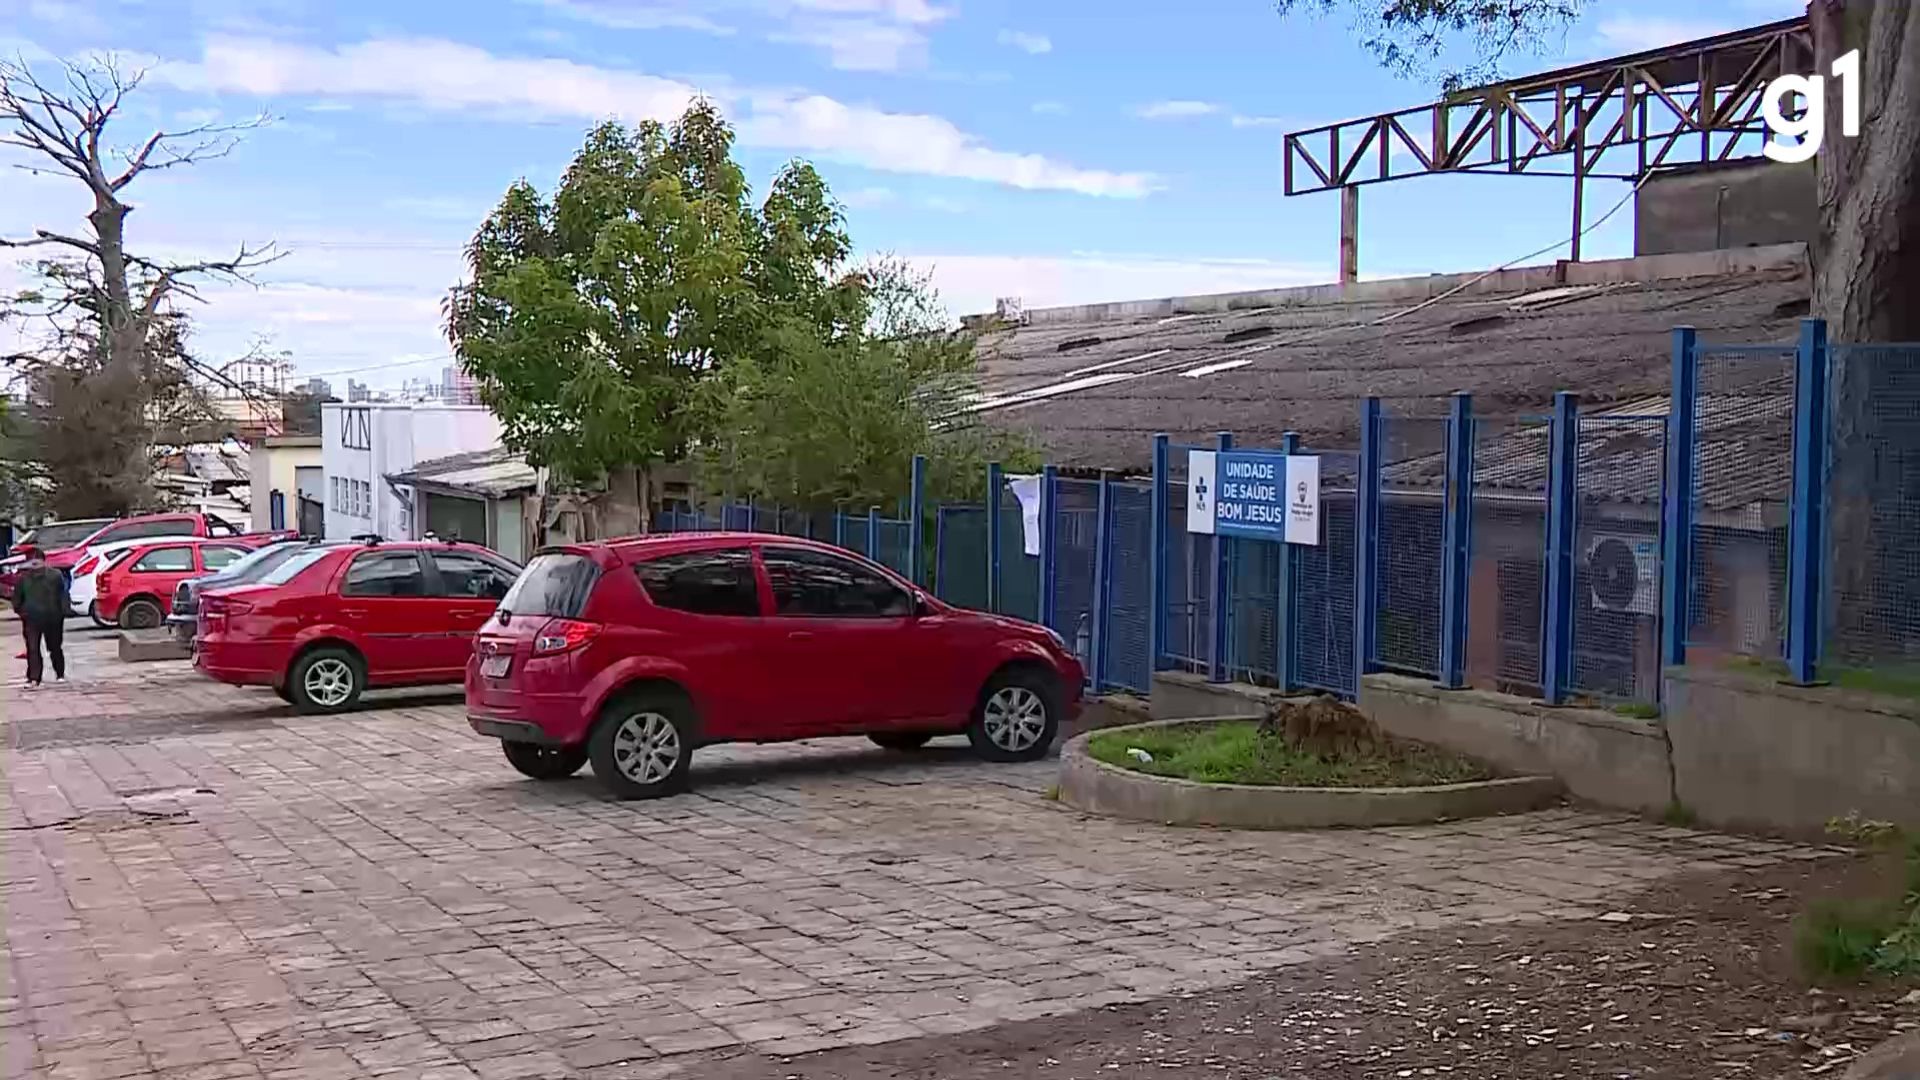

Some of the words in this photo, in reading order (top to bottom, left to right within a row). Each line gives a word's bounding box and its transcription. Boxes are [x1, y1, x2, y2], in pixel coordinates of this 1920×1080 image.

[1226, 461, 1274, 479] UNIDADE
[1223, 483, 1238, 498] DE
[1239, 481, 1276, 501] SAÚDE
[1217, 502, 1242, 520] BOM
[1245, 504, 1282, 523] JESUS
